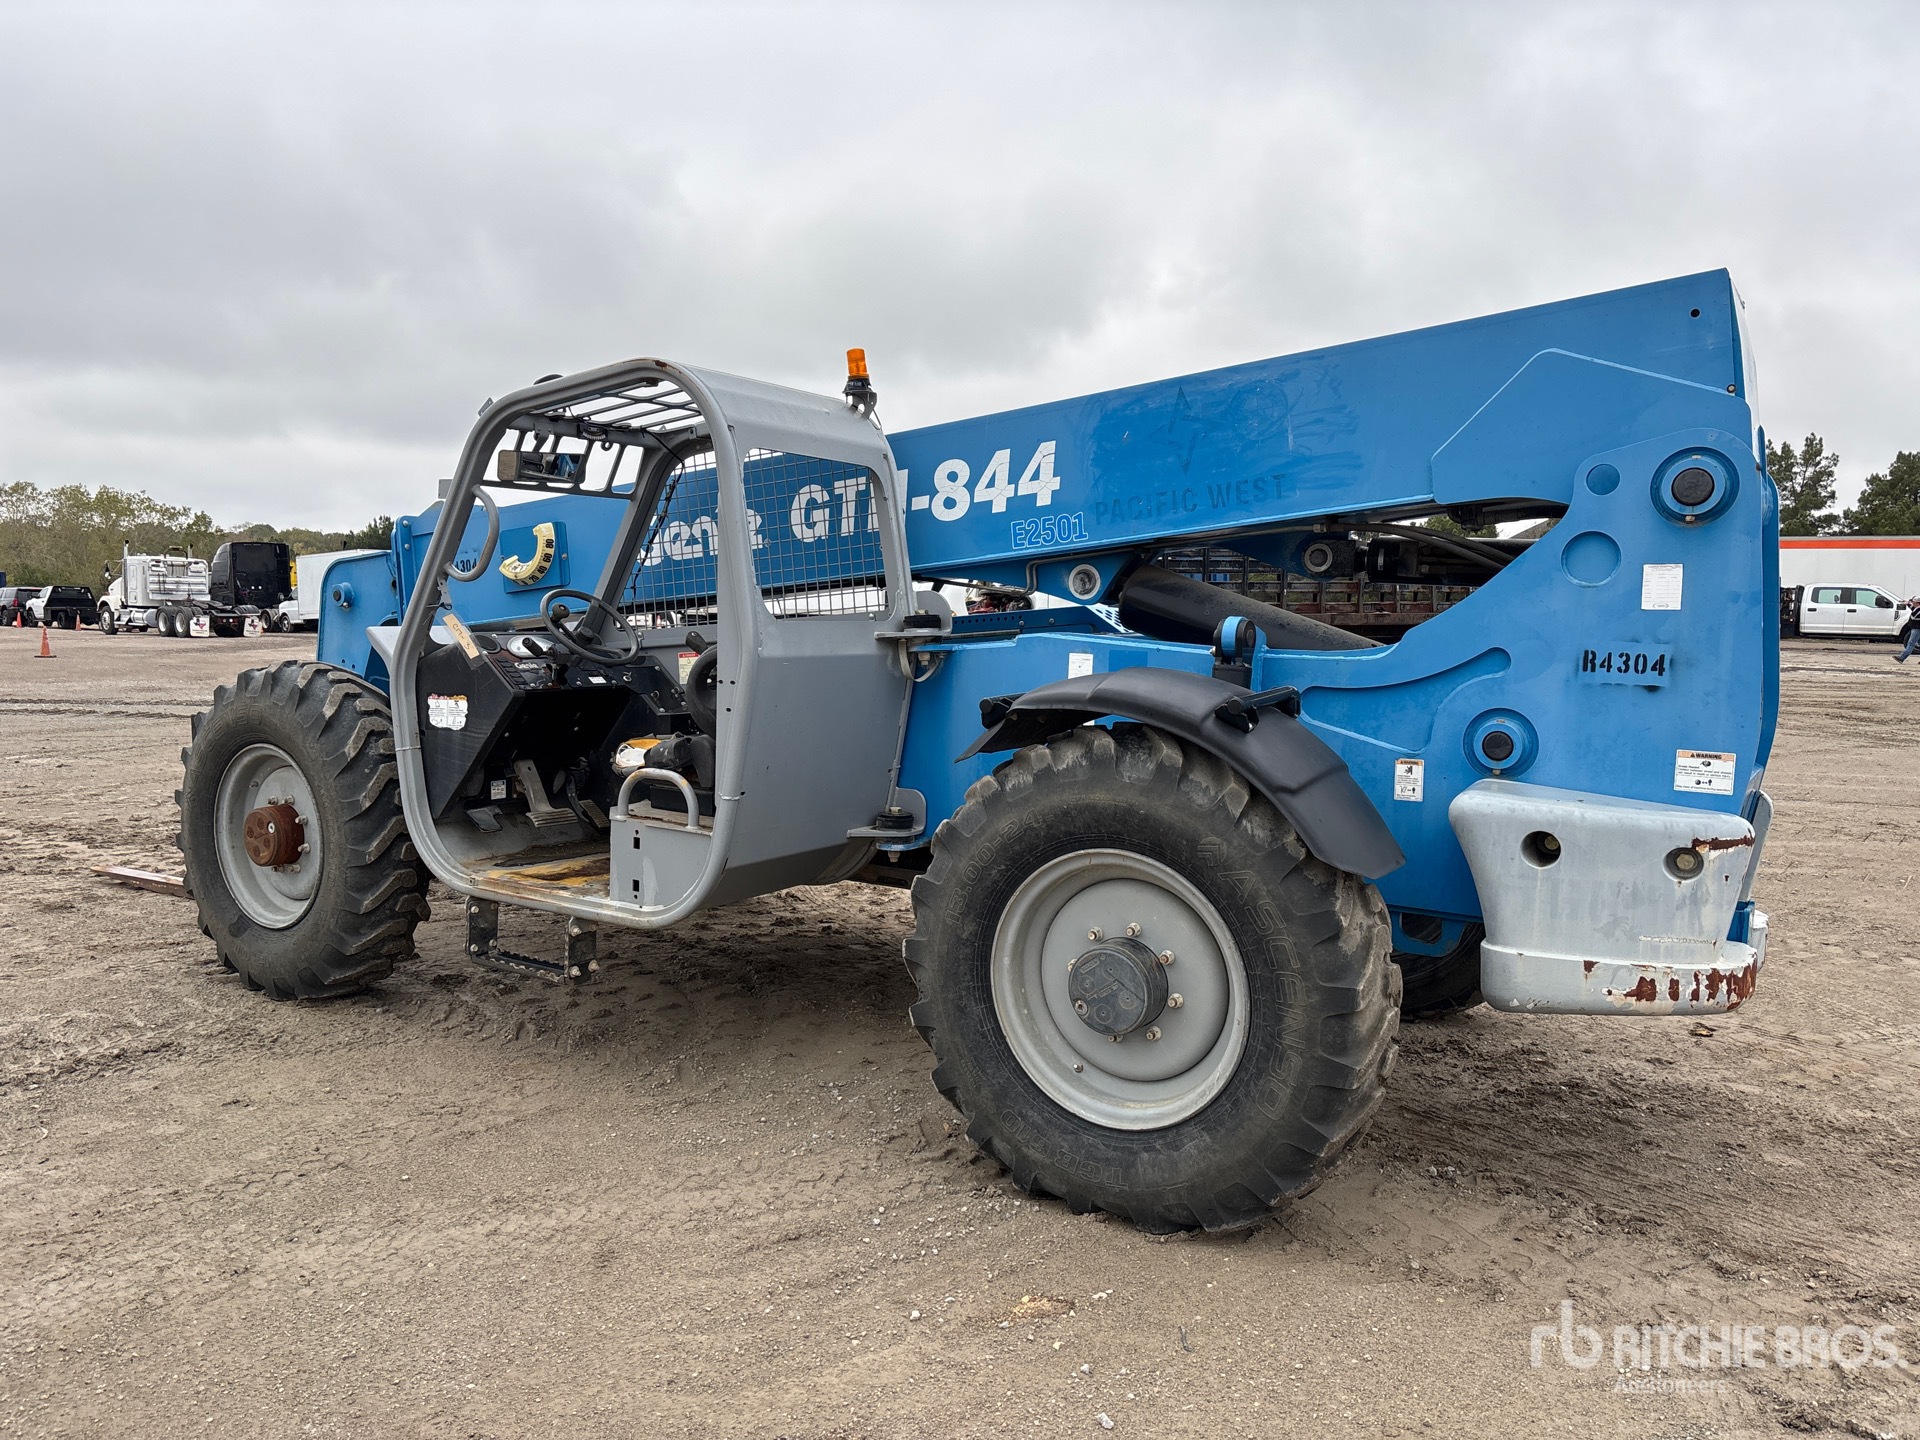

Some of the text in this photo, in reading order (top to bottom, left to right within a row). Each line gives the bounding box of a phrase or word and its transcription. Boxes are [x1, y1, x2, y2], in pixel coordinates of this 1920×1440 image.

[1095, 473, 1288, 526] PACIFIC WEST
[545, 538, 554, 549] 80
[637, 490, 763, 566] ene
[1010, 511, 1089, 550] E2501
[537, 565, 548, 575] 40
[543, 553, 553, 563] 60
[1582, 649, 1666, 677] R4304
[1696, 752, 1722, 760] WARNING
[945, 808, 1043, 925] 13.00-24
[1218, 870, 1307, 1121] ASCENSO
[1054, 1149, 1129, 1190] TGB
